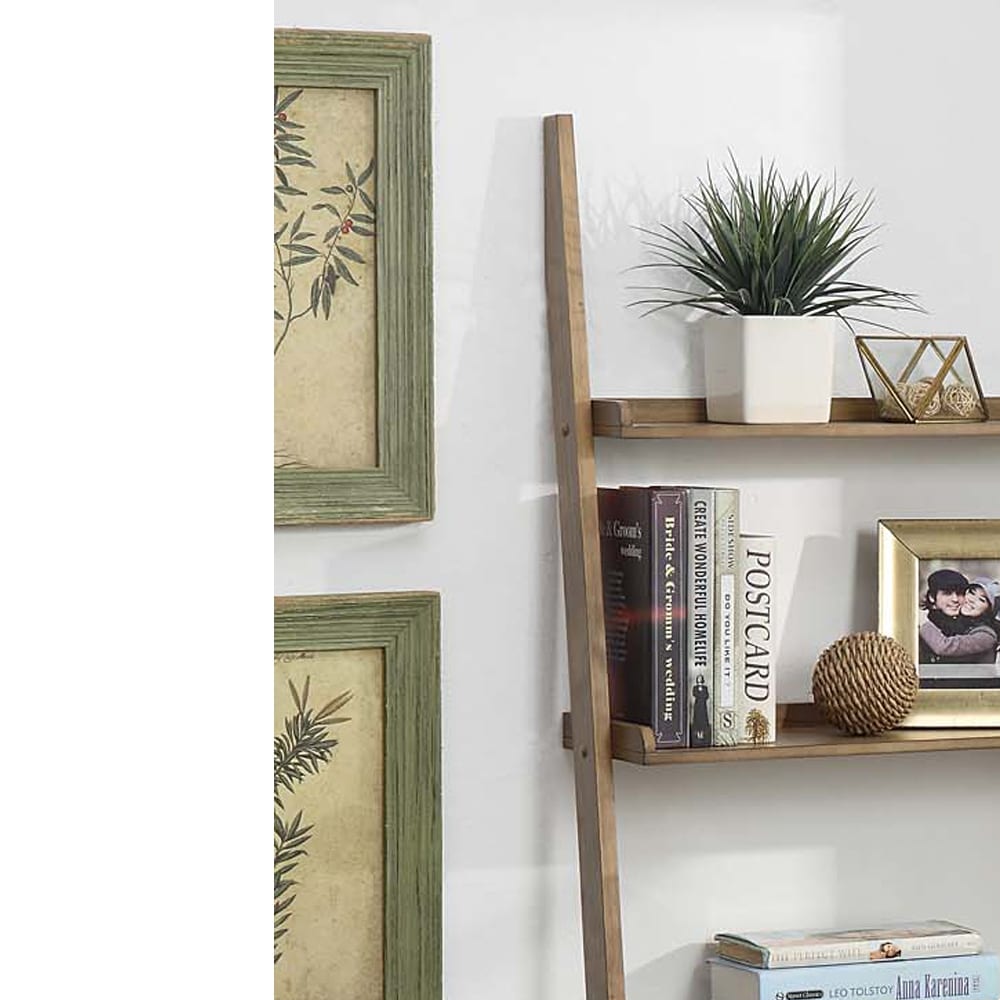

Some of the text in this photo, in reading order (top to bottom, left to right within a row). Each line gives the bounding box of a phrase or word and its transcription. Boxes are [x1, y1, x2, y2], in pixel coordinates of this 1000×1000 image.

[664, 516, 675, 560] Bride
[665, 564, 675, 577] &
[694, 501, 706, 667] CREATE WONDERFUL HOMELIFE
[724, 593, 731, 610] DO
[744, 549, 771, 702] POSTCARD
[724, 666, 731, 676] IT
[664, 658, 675, 721] wedding
[829, 988, 848, 998] LEO
[850, 986, 892, 997] TOLSTOY
[897, 976, 920, 1000] Anna
[924, 973, 969, 998] Karenina
